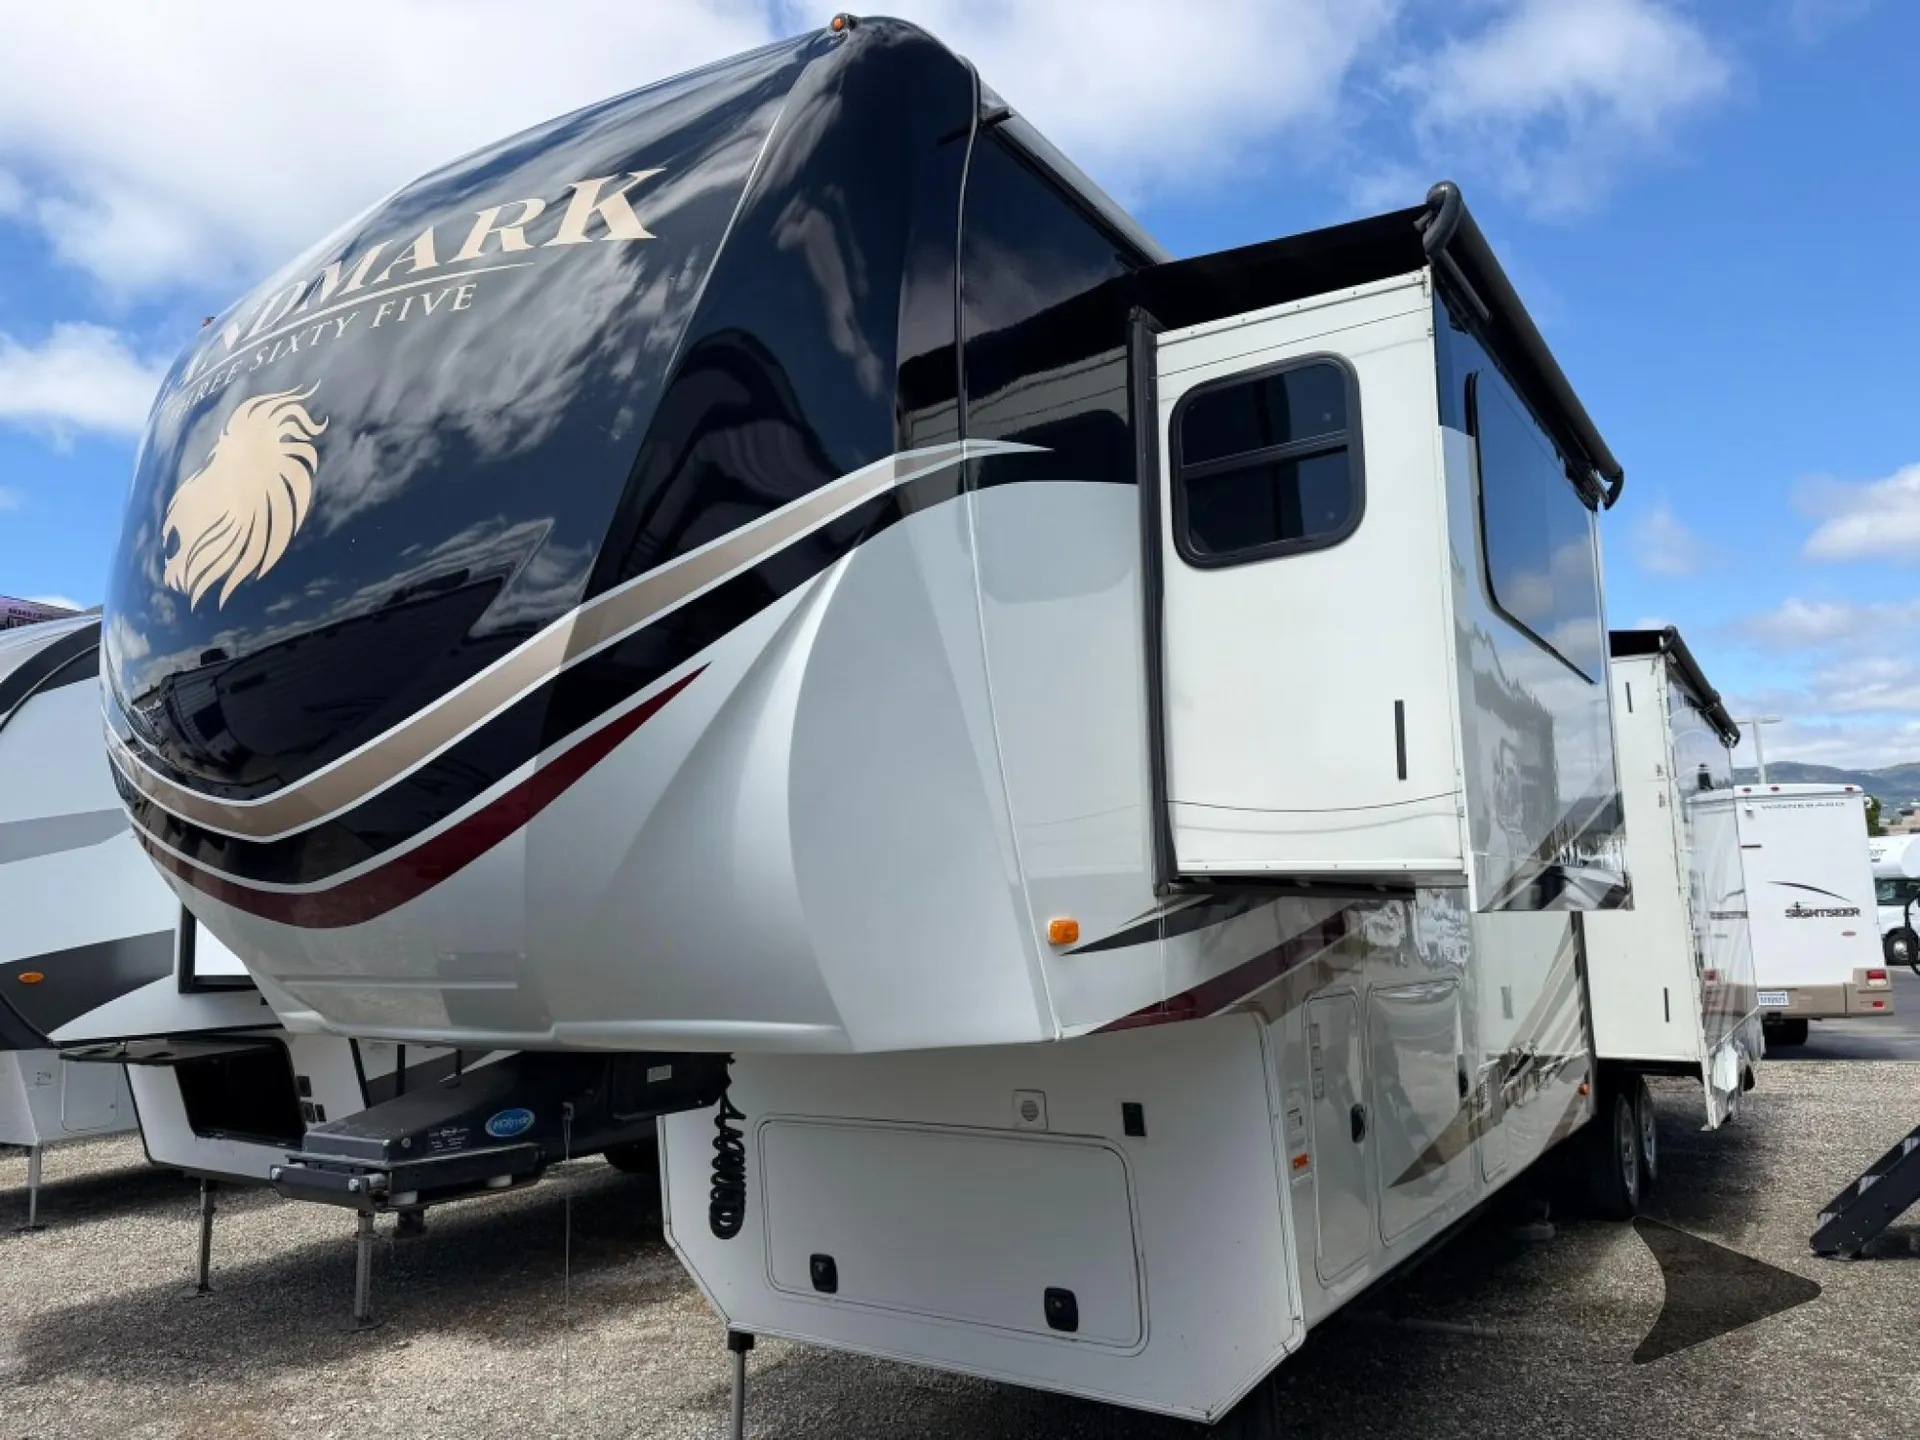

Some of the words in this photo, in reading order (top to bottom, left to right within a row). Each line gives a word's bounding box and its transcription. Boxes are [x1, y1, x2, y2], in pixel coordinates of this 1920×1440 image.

[249, 310, 360, 372] SIXTY
[369, 283, 477, 329] FIVE
[1784, 905, 1861, 919] SIGHTSEER
